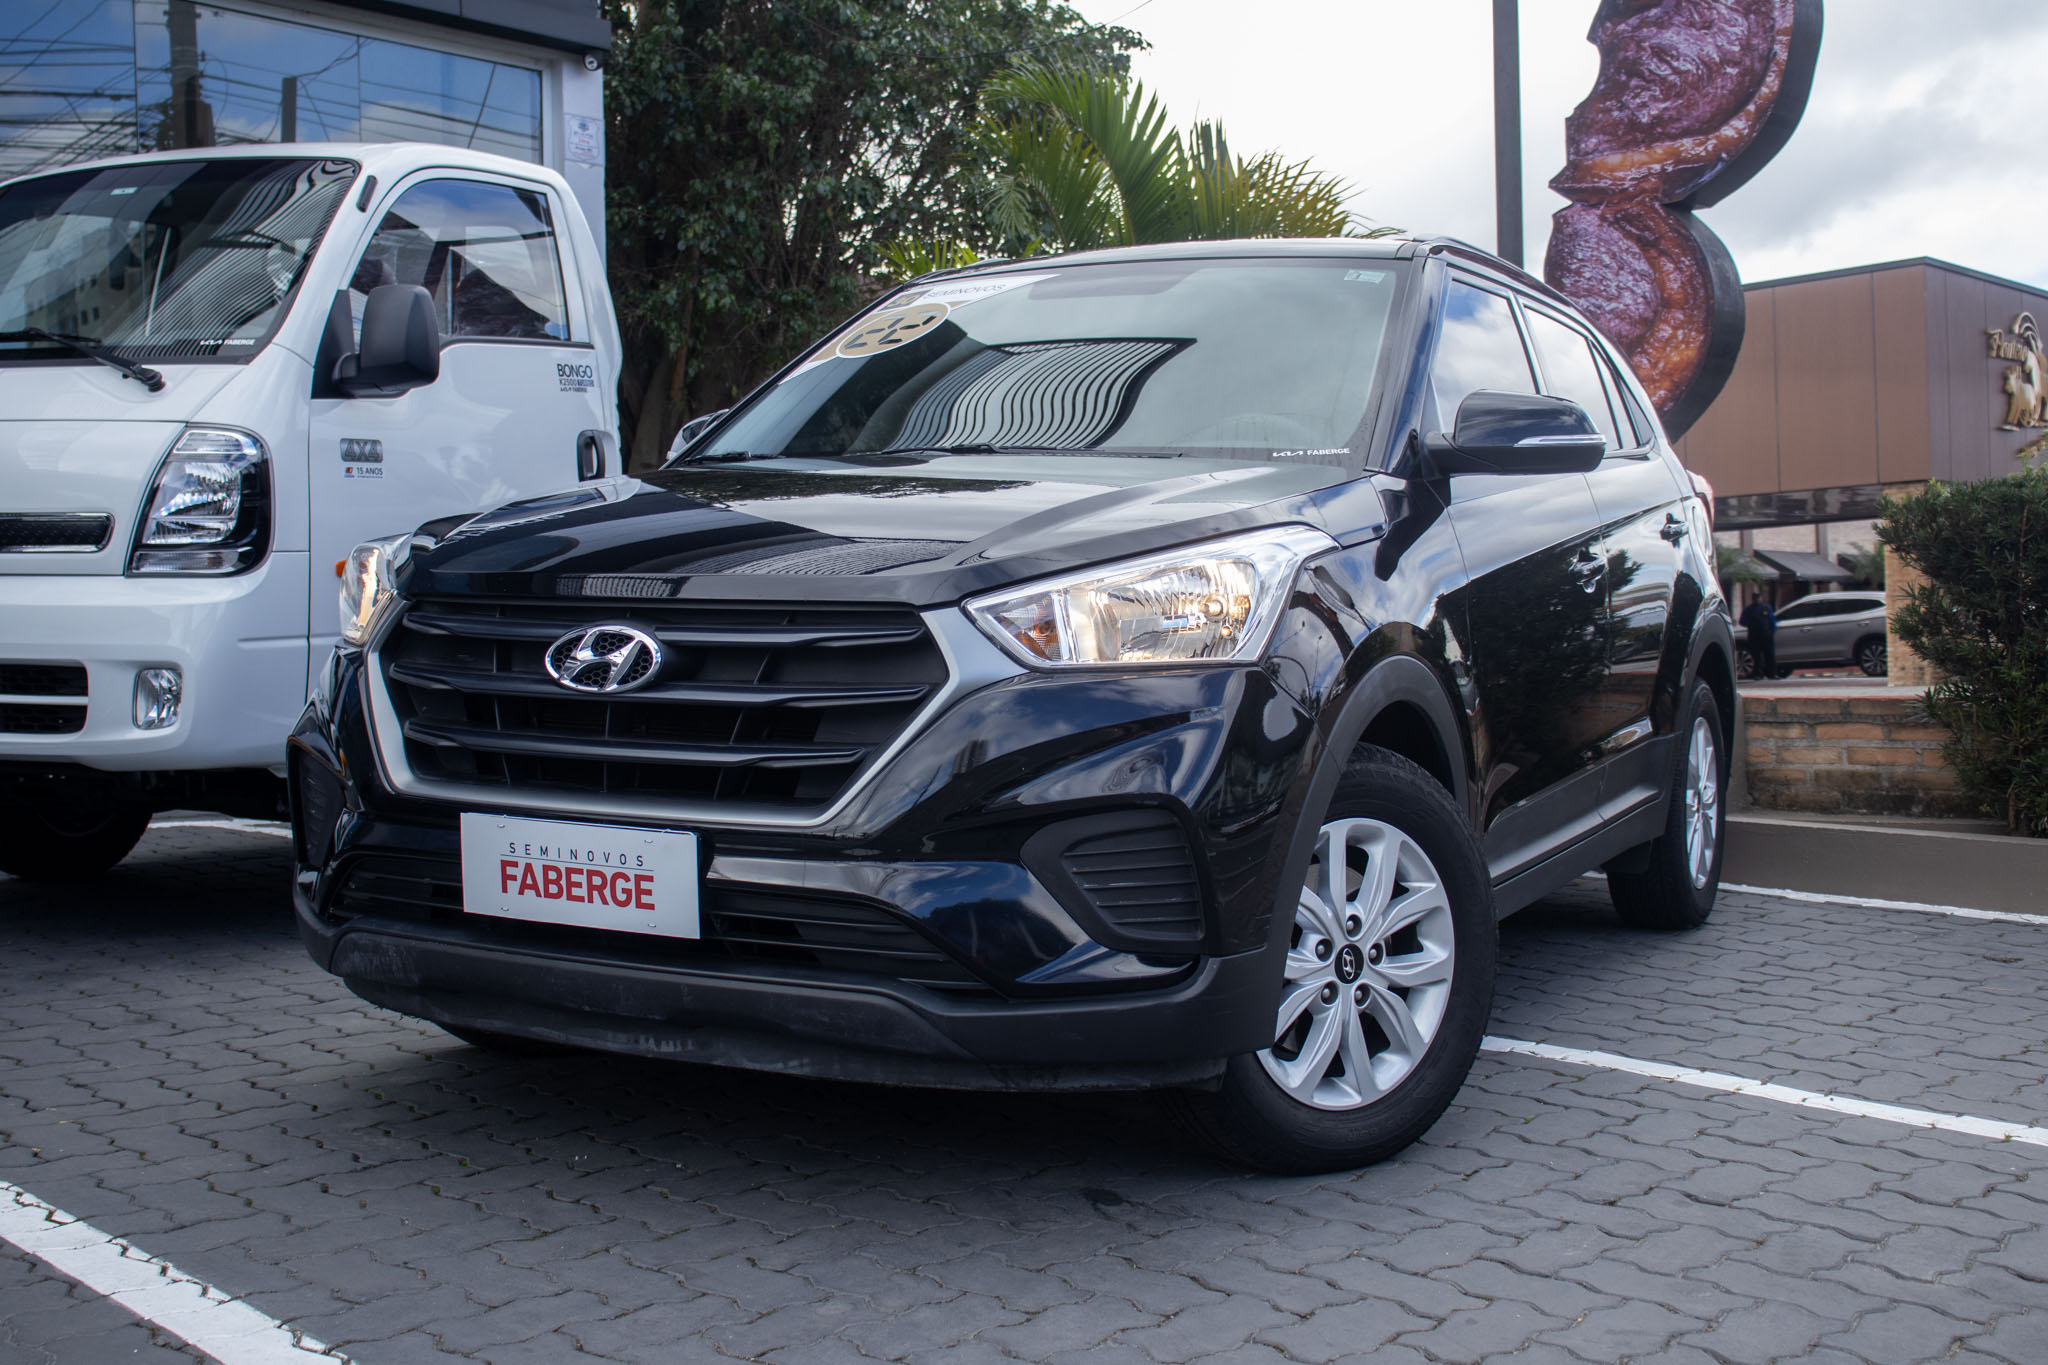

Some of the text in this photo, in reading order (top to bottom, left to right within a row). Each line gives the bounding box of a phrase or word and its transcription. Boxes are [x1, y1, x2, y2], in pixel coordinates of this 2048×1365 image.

[557, 363, 593, 378] BONGO
[1307, 448, 1351, 456] FABERGE
[365, 467, 384, 476] ANOS
[509, 842, 644, 867] SEMINOVOS
[500, 859, 655, 911] FABERGE
